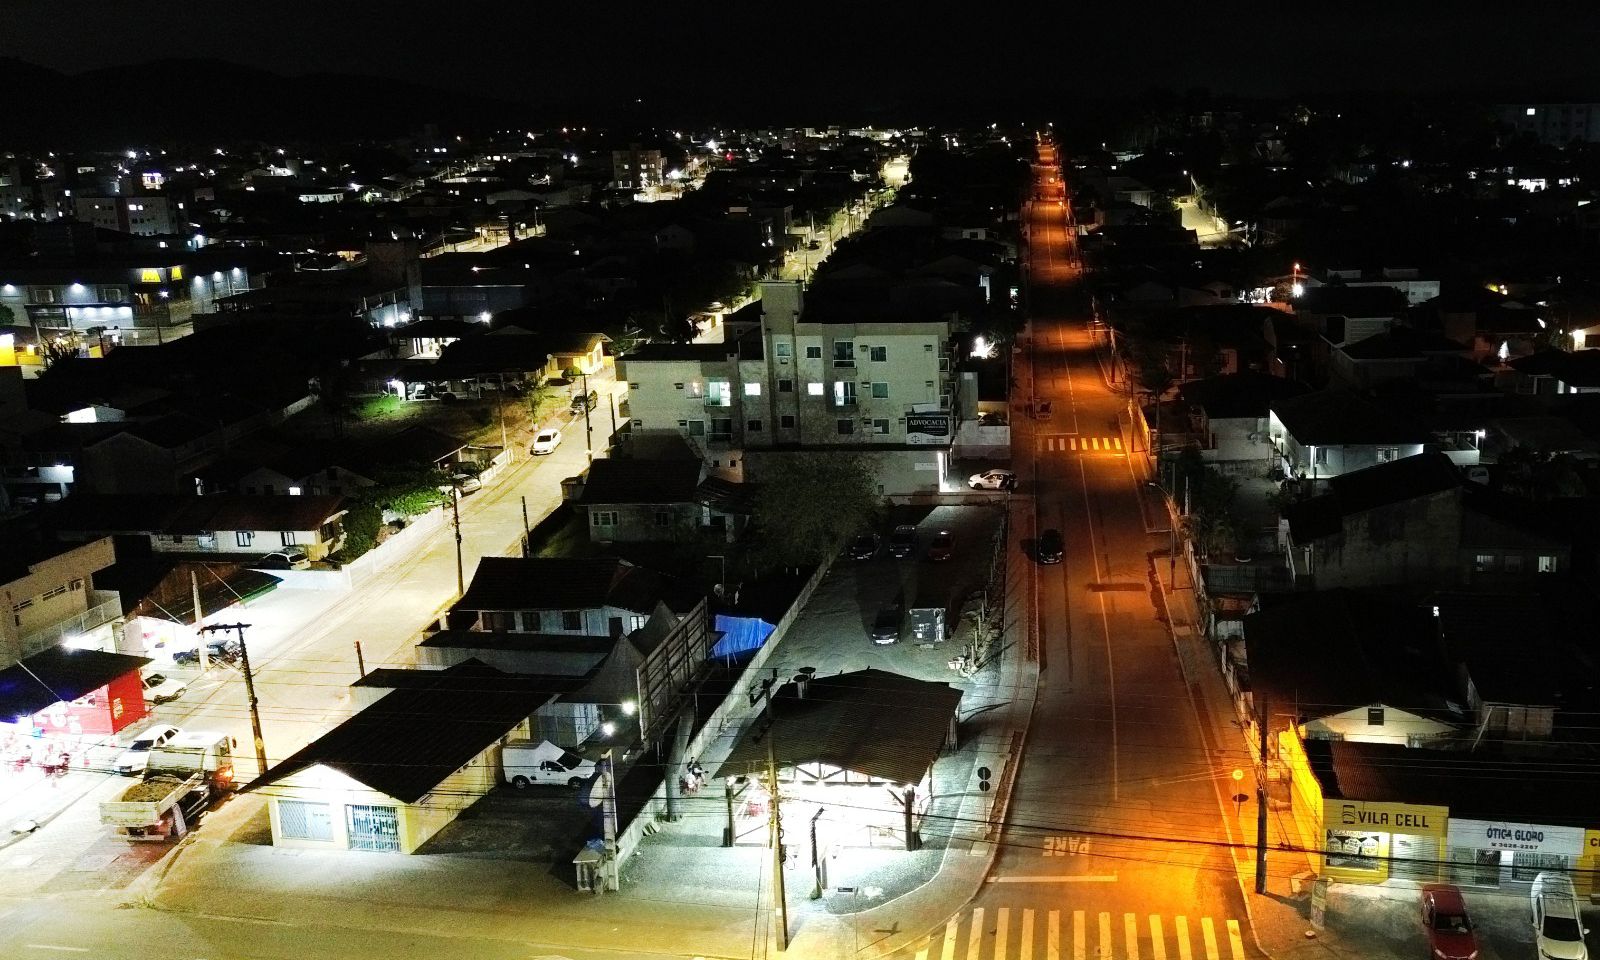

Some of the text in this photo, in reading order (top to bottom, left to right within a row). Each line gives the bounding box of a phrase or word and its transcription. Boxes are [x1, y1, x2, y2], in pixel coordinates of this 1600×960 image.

[1358, 811, 1430, 828] VILA CELL
[1042, 836, 1091, 857] PARE
